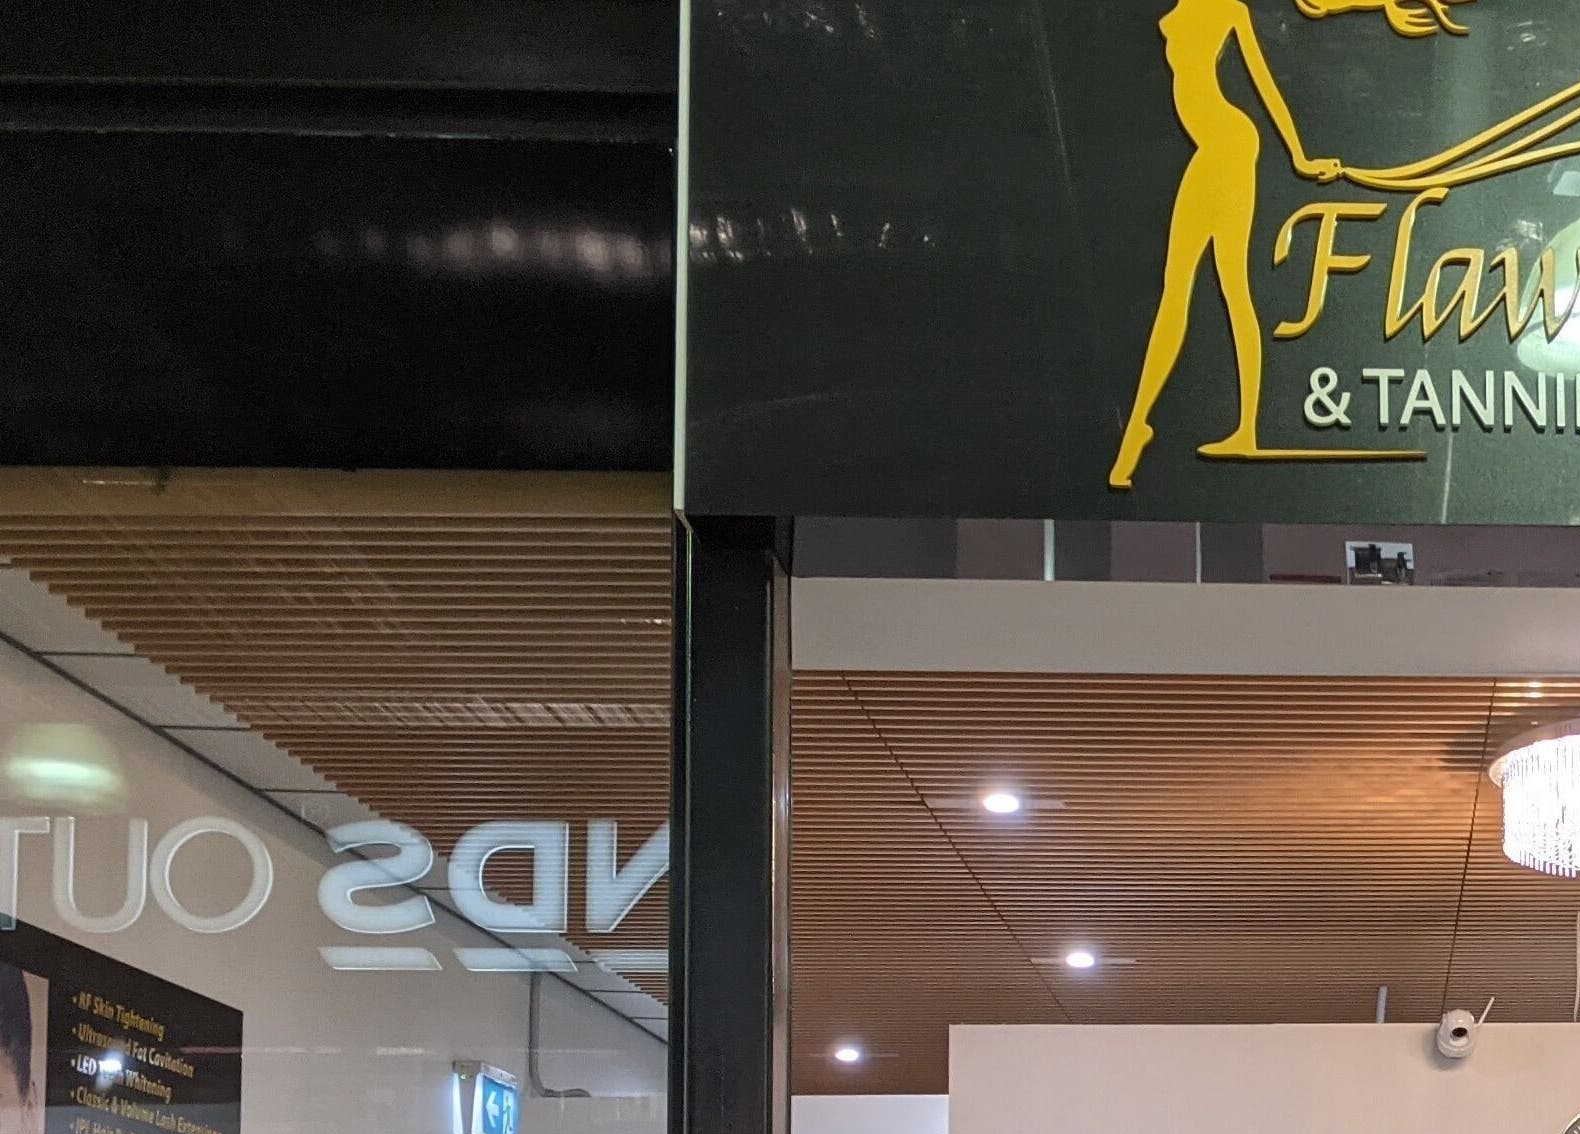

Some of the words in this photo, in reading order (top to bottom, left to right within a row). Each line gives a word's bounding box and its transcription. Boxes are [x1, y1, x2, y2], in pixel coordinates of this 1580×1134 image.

[1303, 368, 1353, 429] &
[93, 996, 114, 1020] Skin
[115, 1004, 165, 1042] Tightening
[77, 1054, 97, 1076] LED
[125, 1069, 173, 1104] Whitening
[132, 1039, 148, 1063] Fat
[149, 1047, 194, 1079] Cavitation
[77, 1086, 111, 1113] Classic
[119, 1099, 154, 1124] Volume
[156, 1110, 177, 1131] Lash
